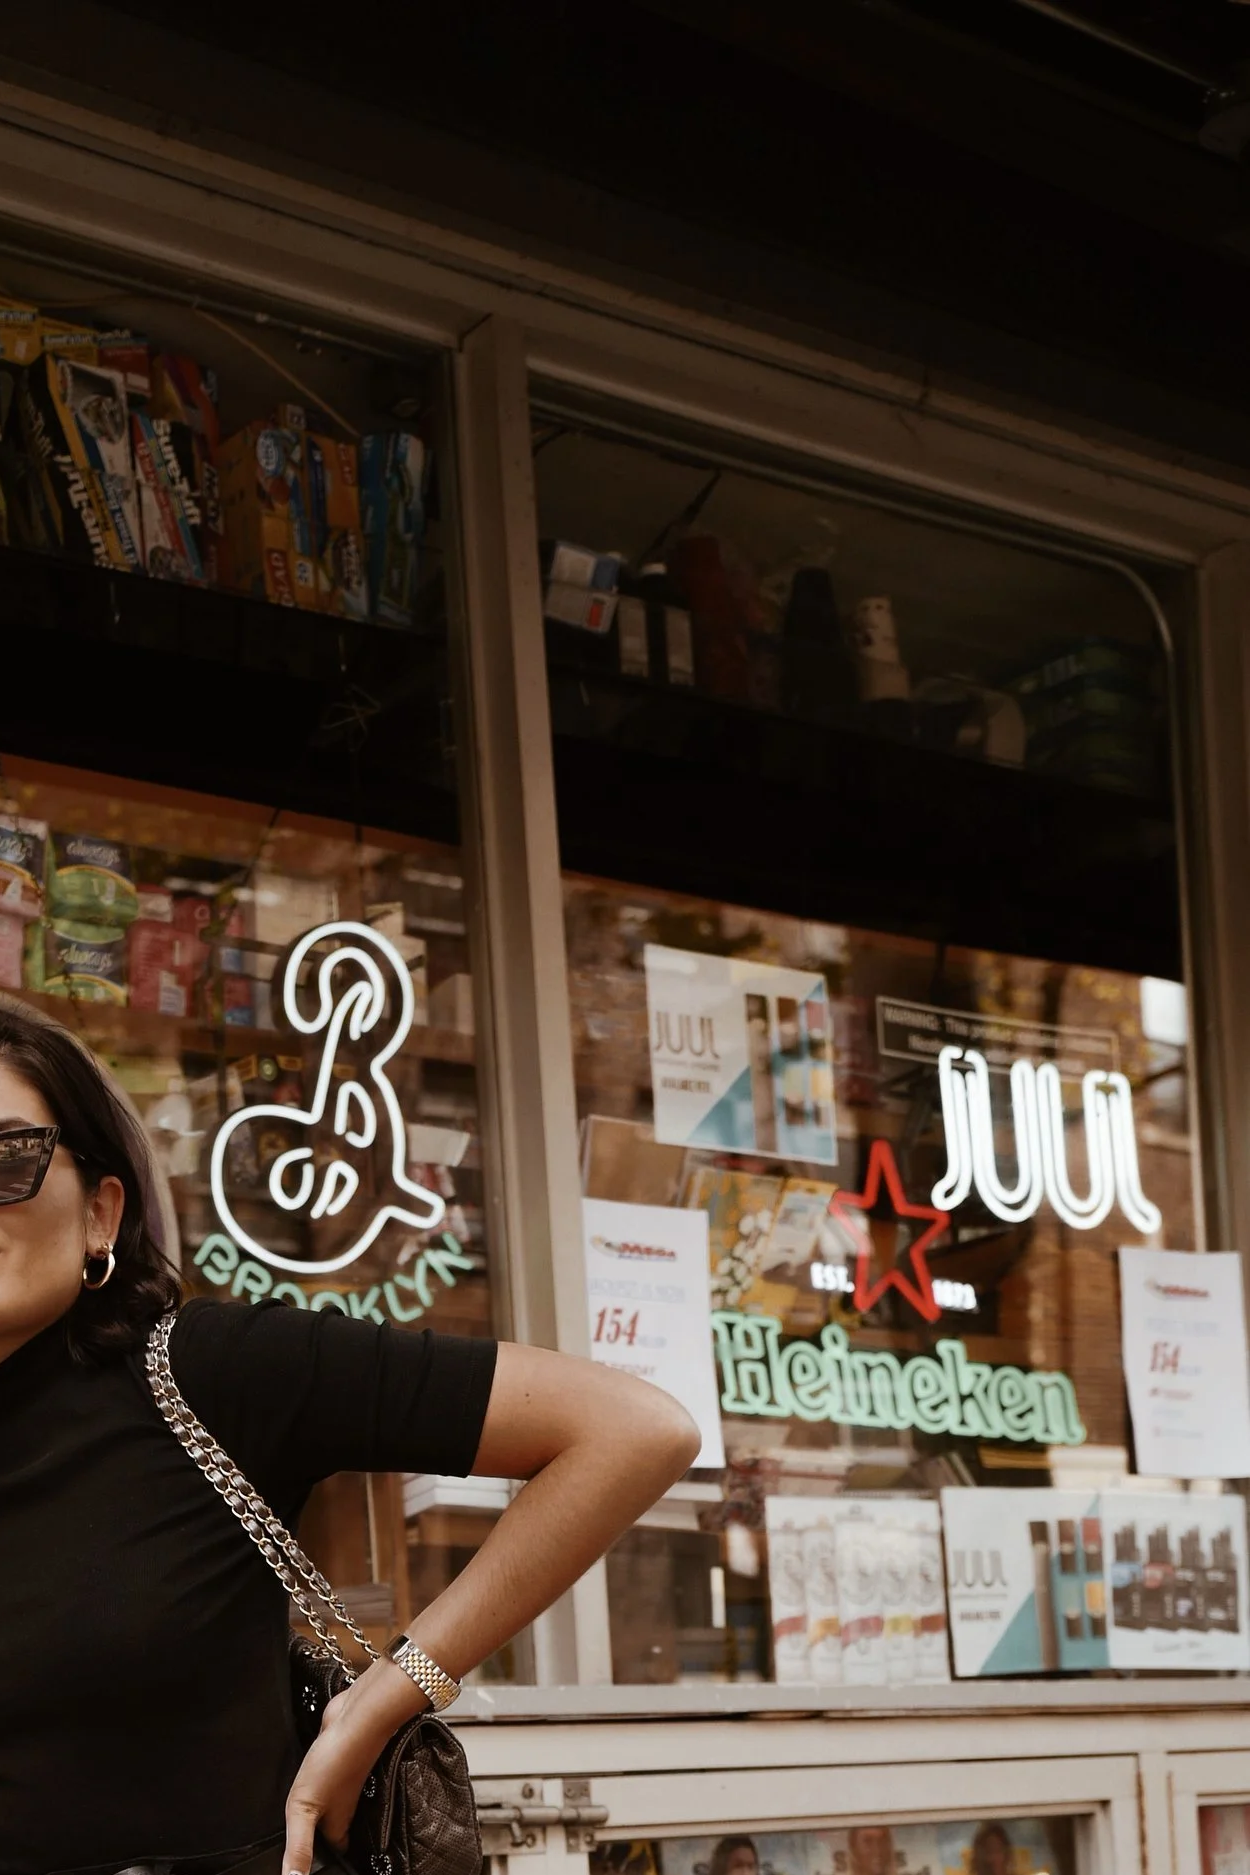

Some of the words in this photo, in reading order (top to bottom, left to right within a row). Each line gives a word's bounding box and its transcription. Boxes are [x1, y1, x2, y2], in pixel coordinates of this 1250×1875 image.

[653, 1010, 720, 1060] JUUL
[931, 1045, 1163, 1234] JUUL
[193, 1231, 475, 1326] BROOKLYN
[811, 1262, 856, 1293] EST.
[593, 1306, 640, 1346] 154
[711, 1310, 1087, 1445] Heineken
